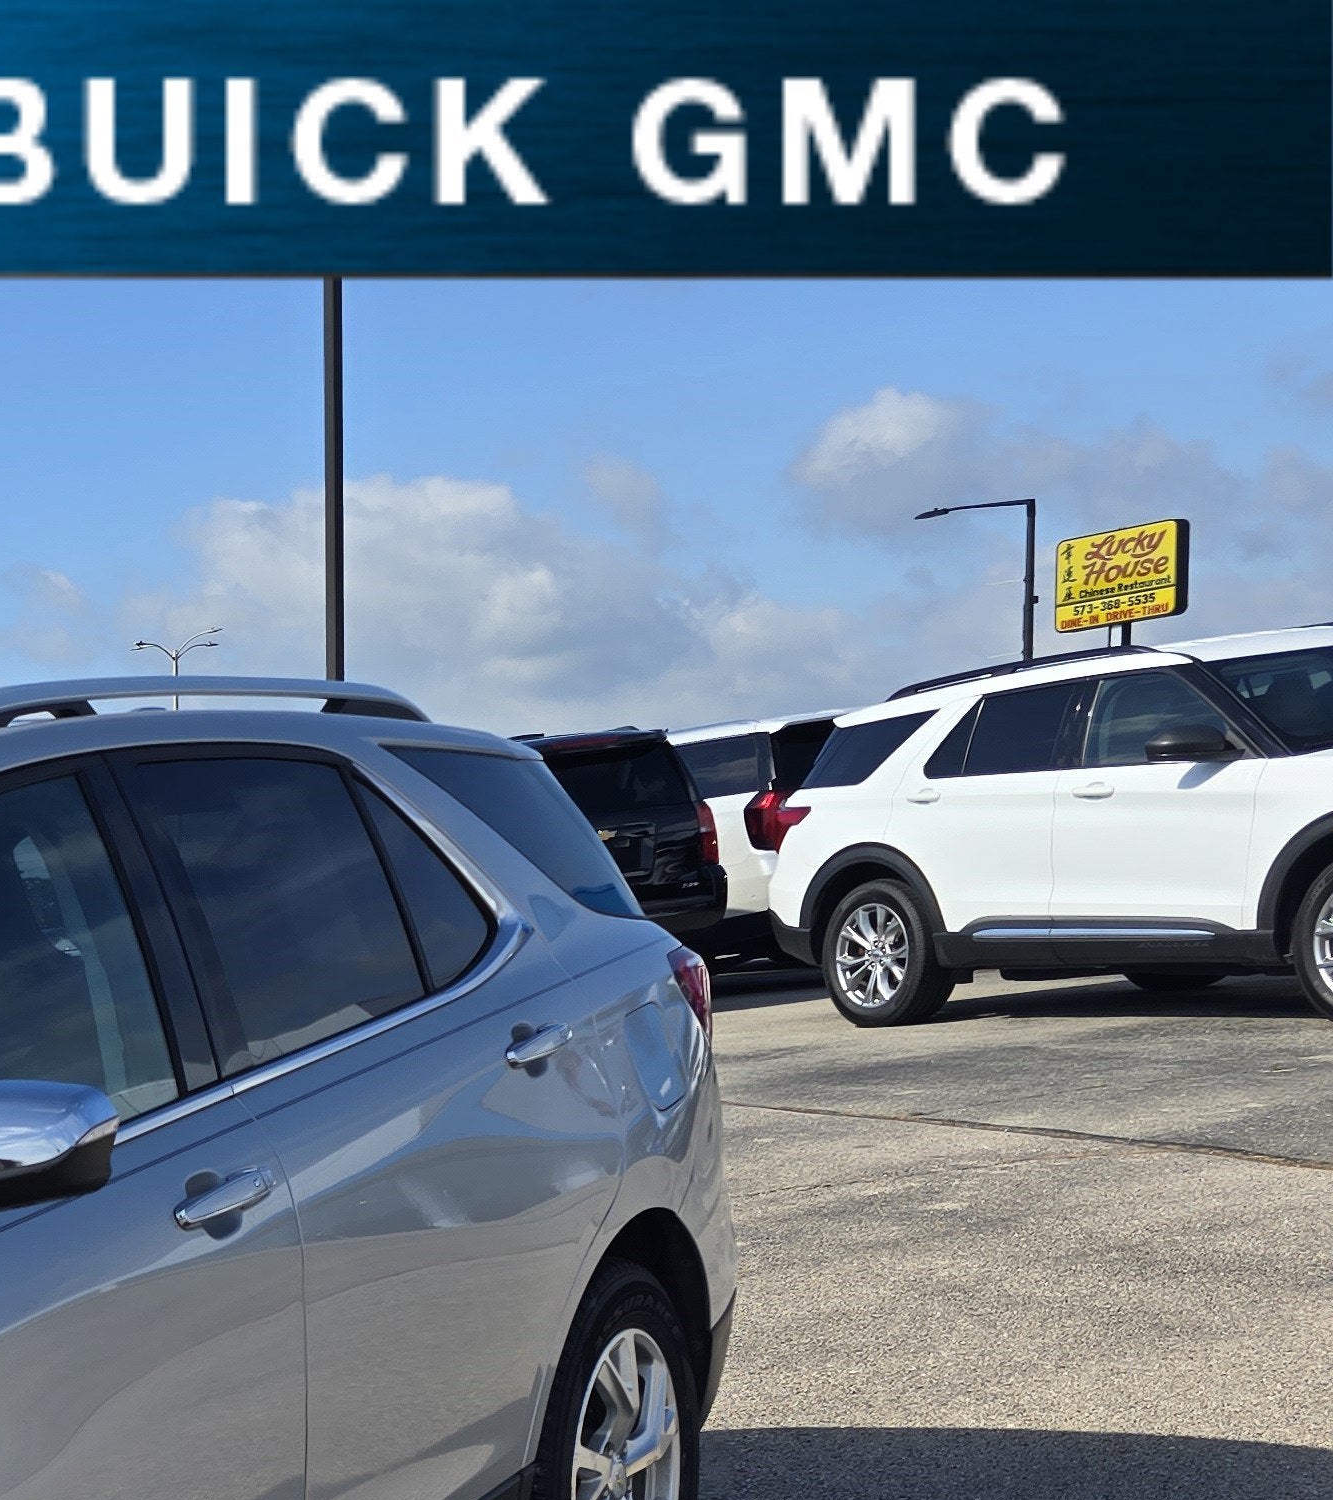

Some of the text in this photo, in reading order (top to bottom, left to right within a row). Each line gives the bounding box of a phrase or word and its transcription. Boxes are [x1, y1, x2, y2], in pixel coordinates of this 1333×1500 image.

[1084, 529, 1167, 561] Lucky
[1082, 555, 1169, 586] House
[1079, 576, 1171, 599] Chinese Restaurant
[1061, 603, 1169, 629] DINE-IN DRIVE-THRU
[1073, 593, 1156, 616] 573-368-5535
